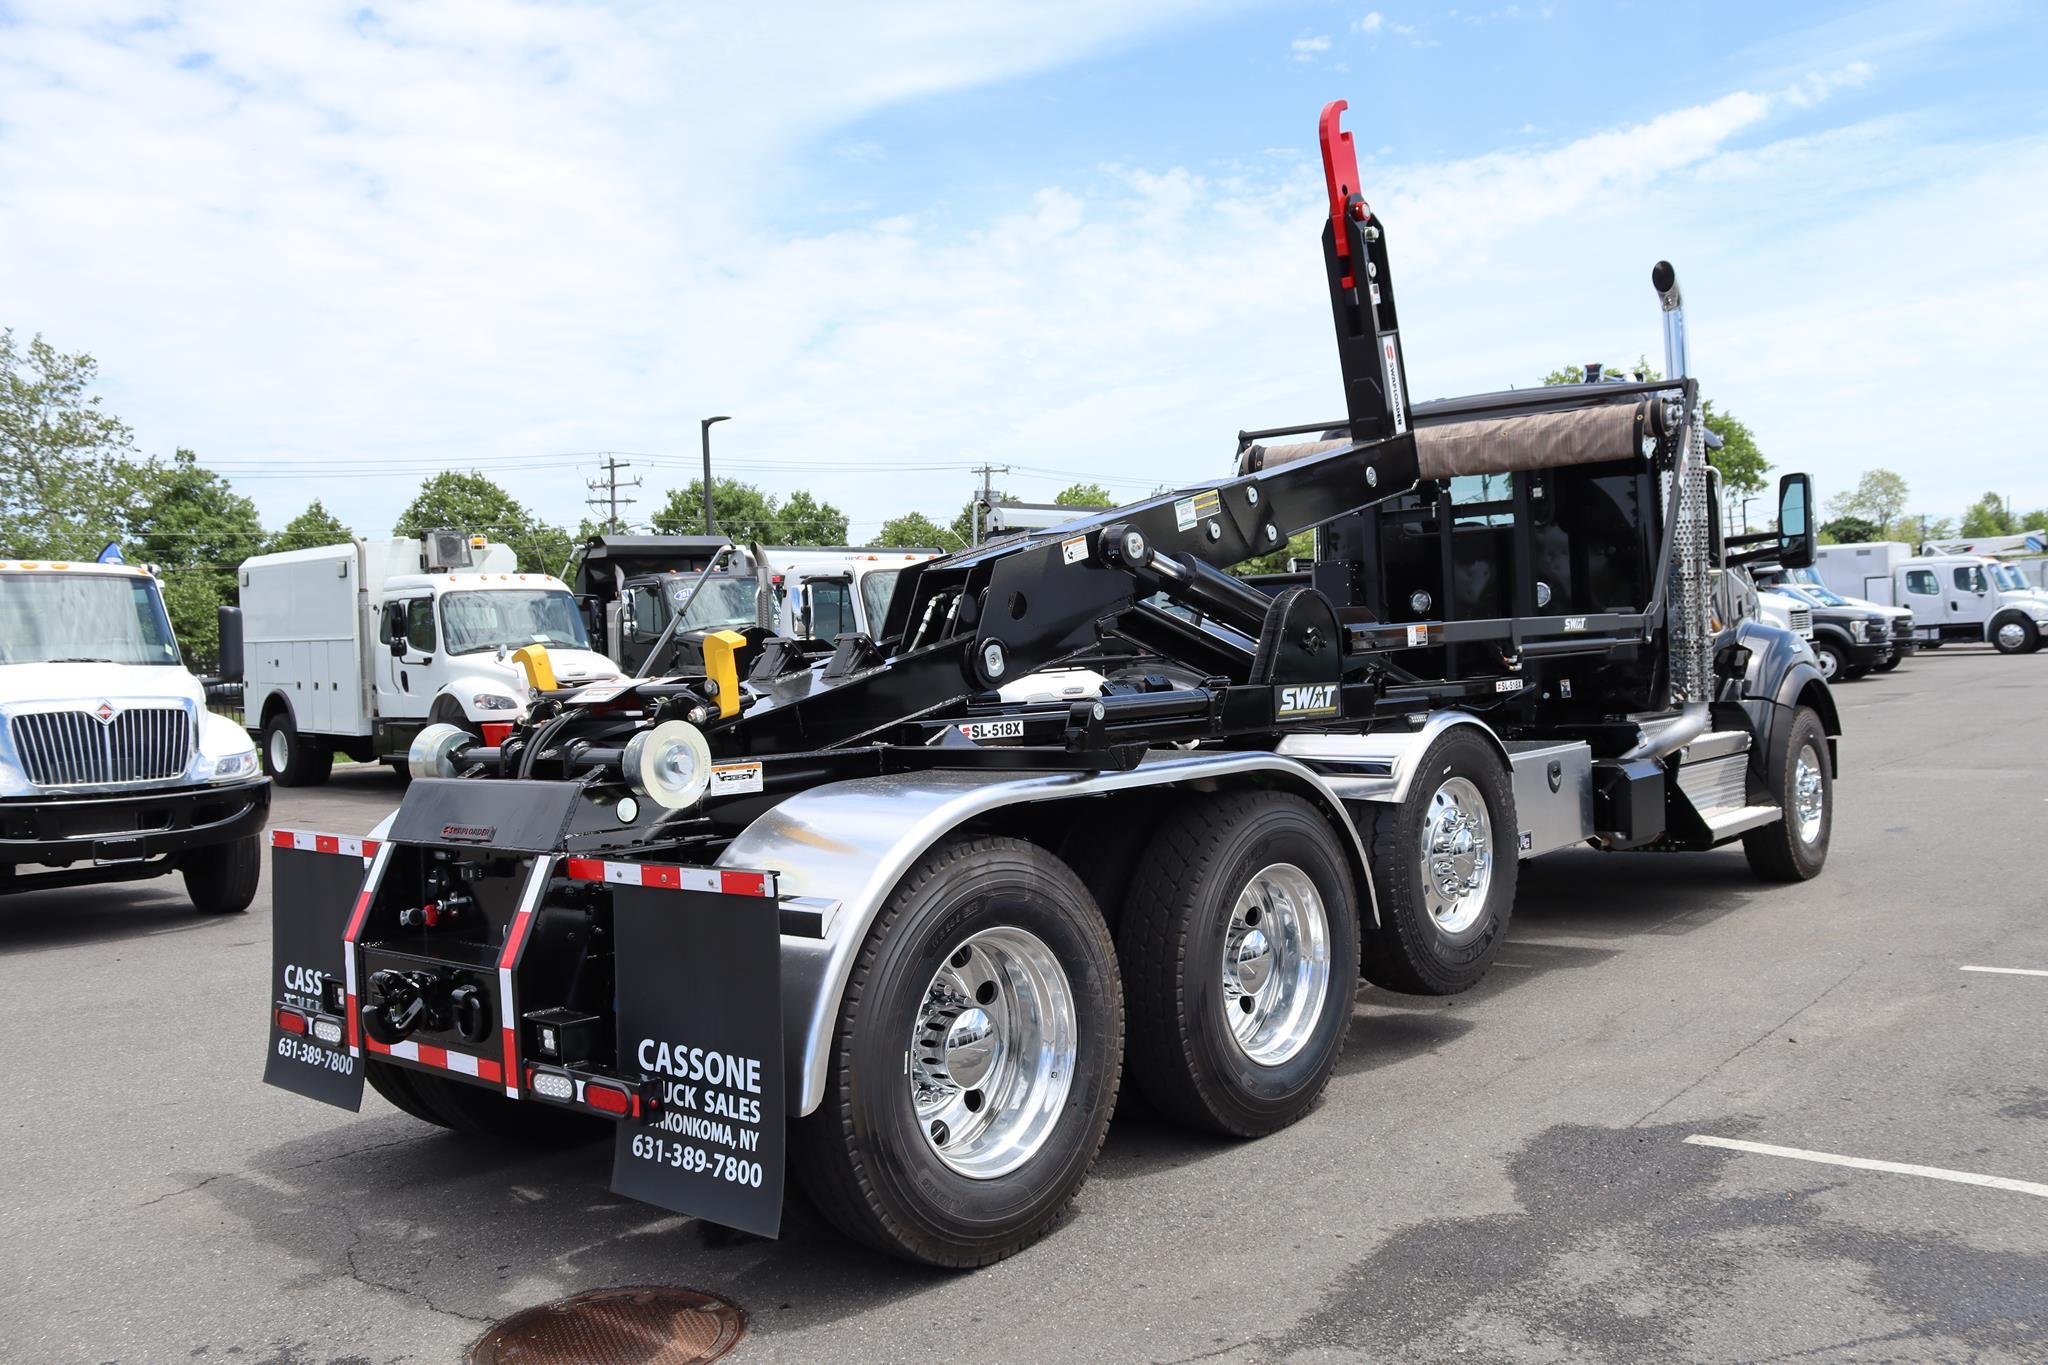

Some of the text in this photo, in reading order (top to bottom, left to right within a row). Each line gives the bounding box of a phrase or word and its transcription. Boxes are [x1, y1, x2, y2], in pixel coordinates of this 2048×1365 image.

[1564, 617, 1586, 629] SWAT
[1280, 685, 1337, 711] SWAT
[971, 722, 1021, 739] SL-518X
[284, 964, 331, 996] CASS
[278, 1037, 354, 1075] 631-389-7800
[638, 1038, 761, 1094] CASSONE
[662, 1080, 761, 1124] UCK SALES
[649, 1110, 760, 1152] KONKOMA, NY
[632, 1134, 763, 1188] 631-389-7800
